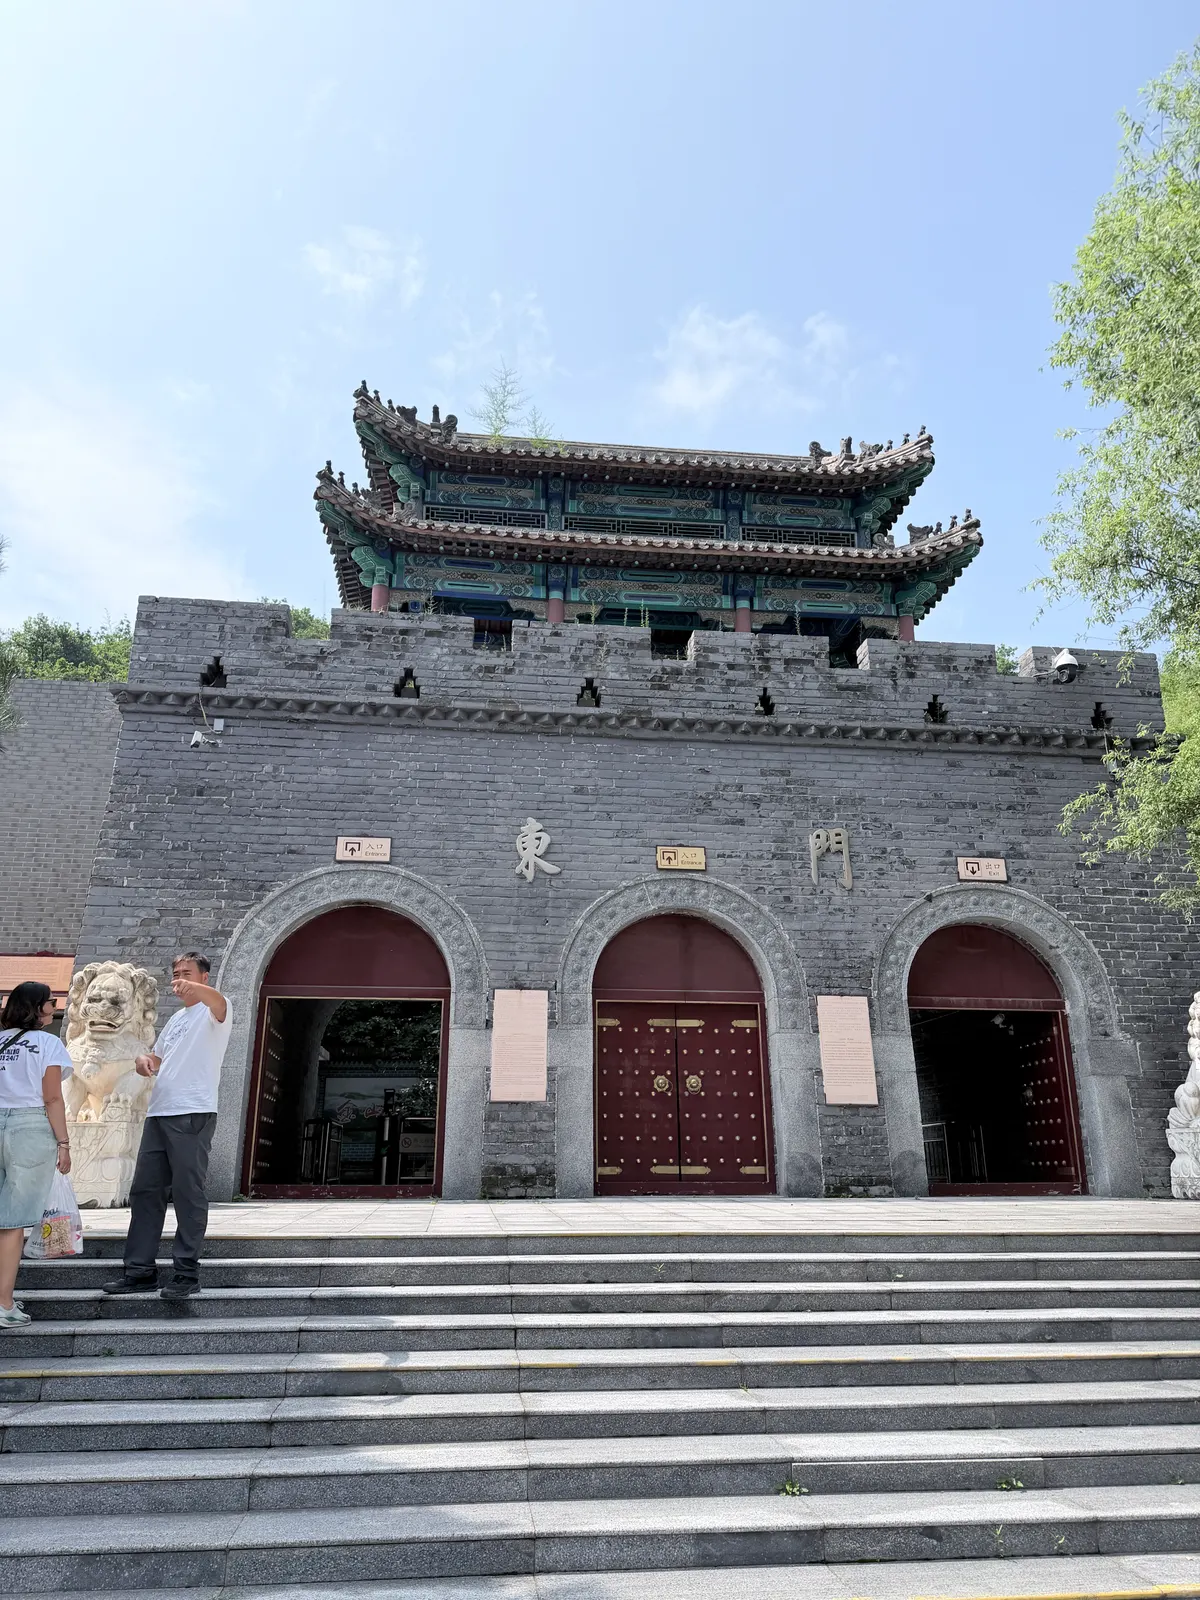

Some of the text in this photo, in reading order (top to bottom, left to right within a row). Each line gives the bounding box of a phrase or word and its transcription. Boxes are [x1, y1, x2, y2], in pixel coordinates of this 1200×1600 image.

[515, 817, 853, 891] 東 門
[985, 862, 1001, 870] 出口
